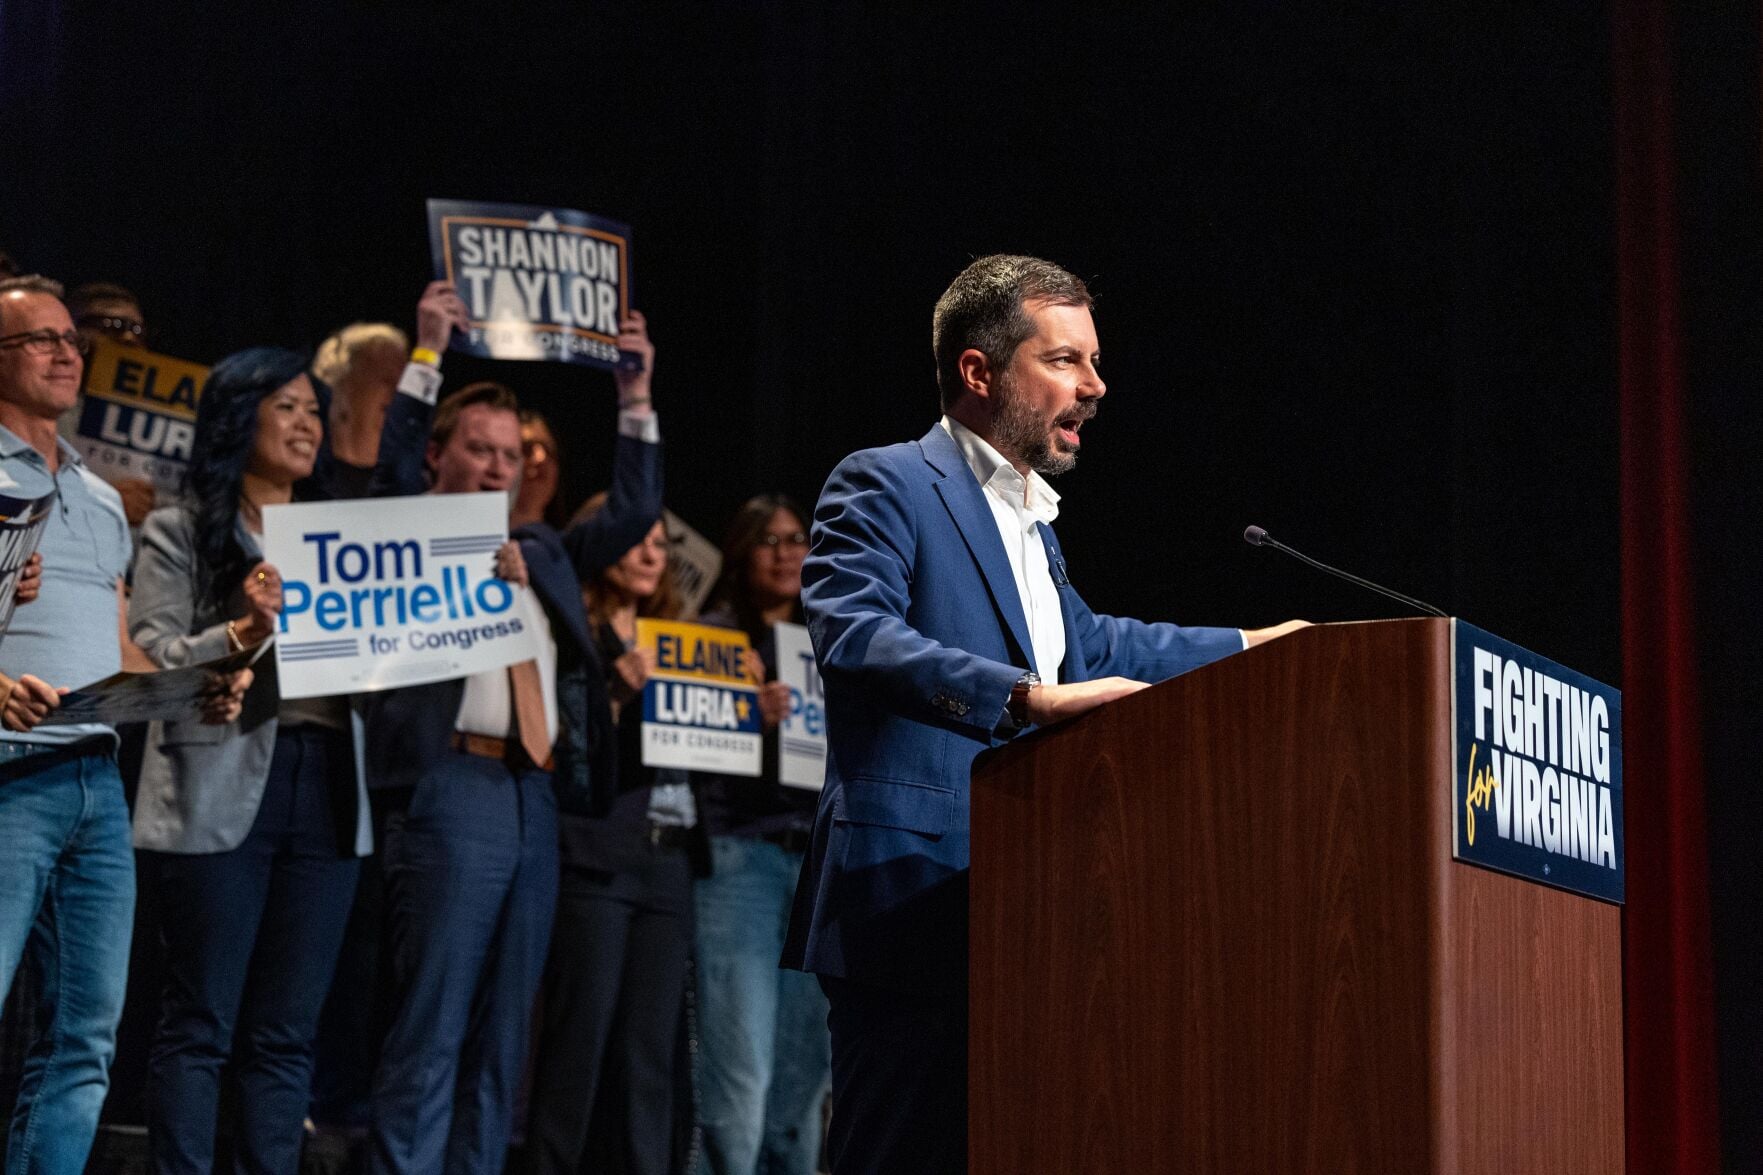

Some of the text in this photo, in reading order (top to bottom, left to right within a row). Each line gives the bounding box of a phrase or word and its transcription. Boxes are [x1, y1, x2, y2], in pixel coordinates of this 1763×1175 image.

[457, 226, 619, 285] SHANNON
[461, 266, 620, 336] TAYLOR
[527, 332, 621, 363] ONGRESS
[114, 357, 196, 411] ELA
[101, 403, 196, 461] LUR
[303, 531, 422, 584] Tom
[278, 564, 514, 633] Perriello
[370, 618, 524, 655] for Congress
[656, 634, 746, 678] ELAINE
[655, 681, 739, 730] LURIA
[1474, 646, 1611, 784] FIGHTING
[651, 729, 754, 753] FOR CONGRESS
[1466, 743, 1616, 870] for VIRGINIA
